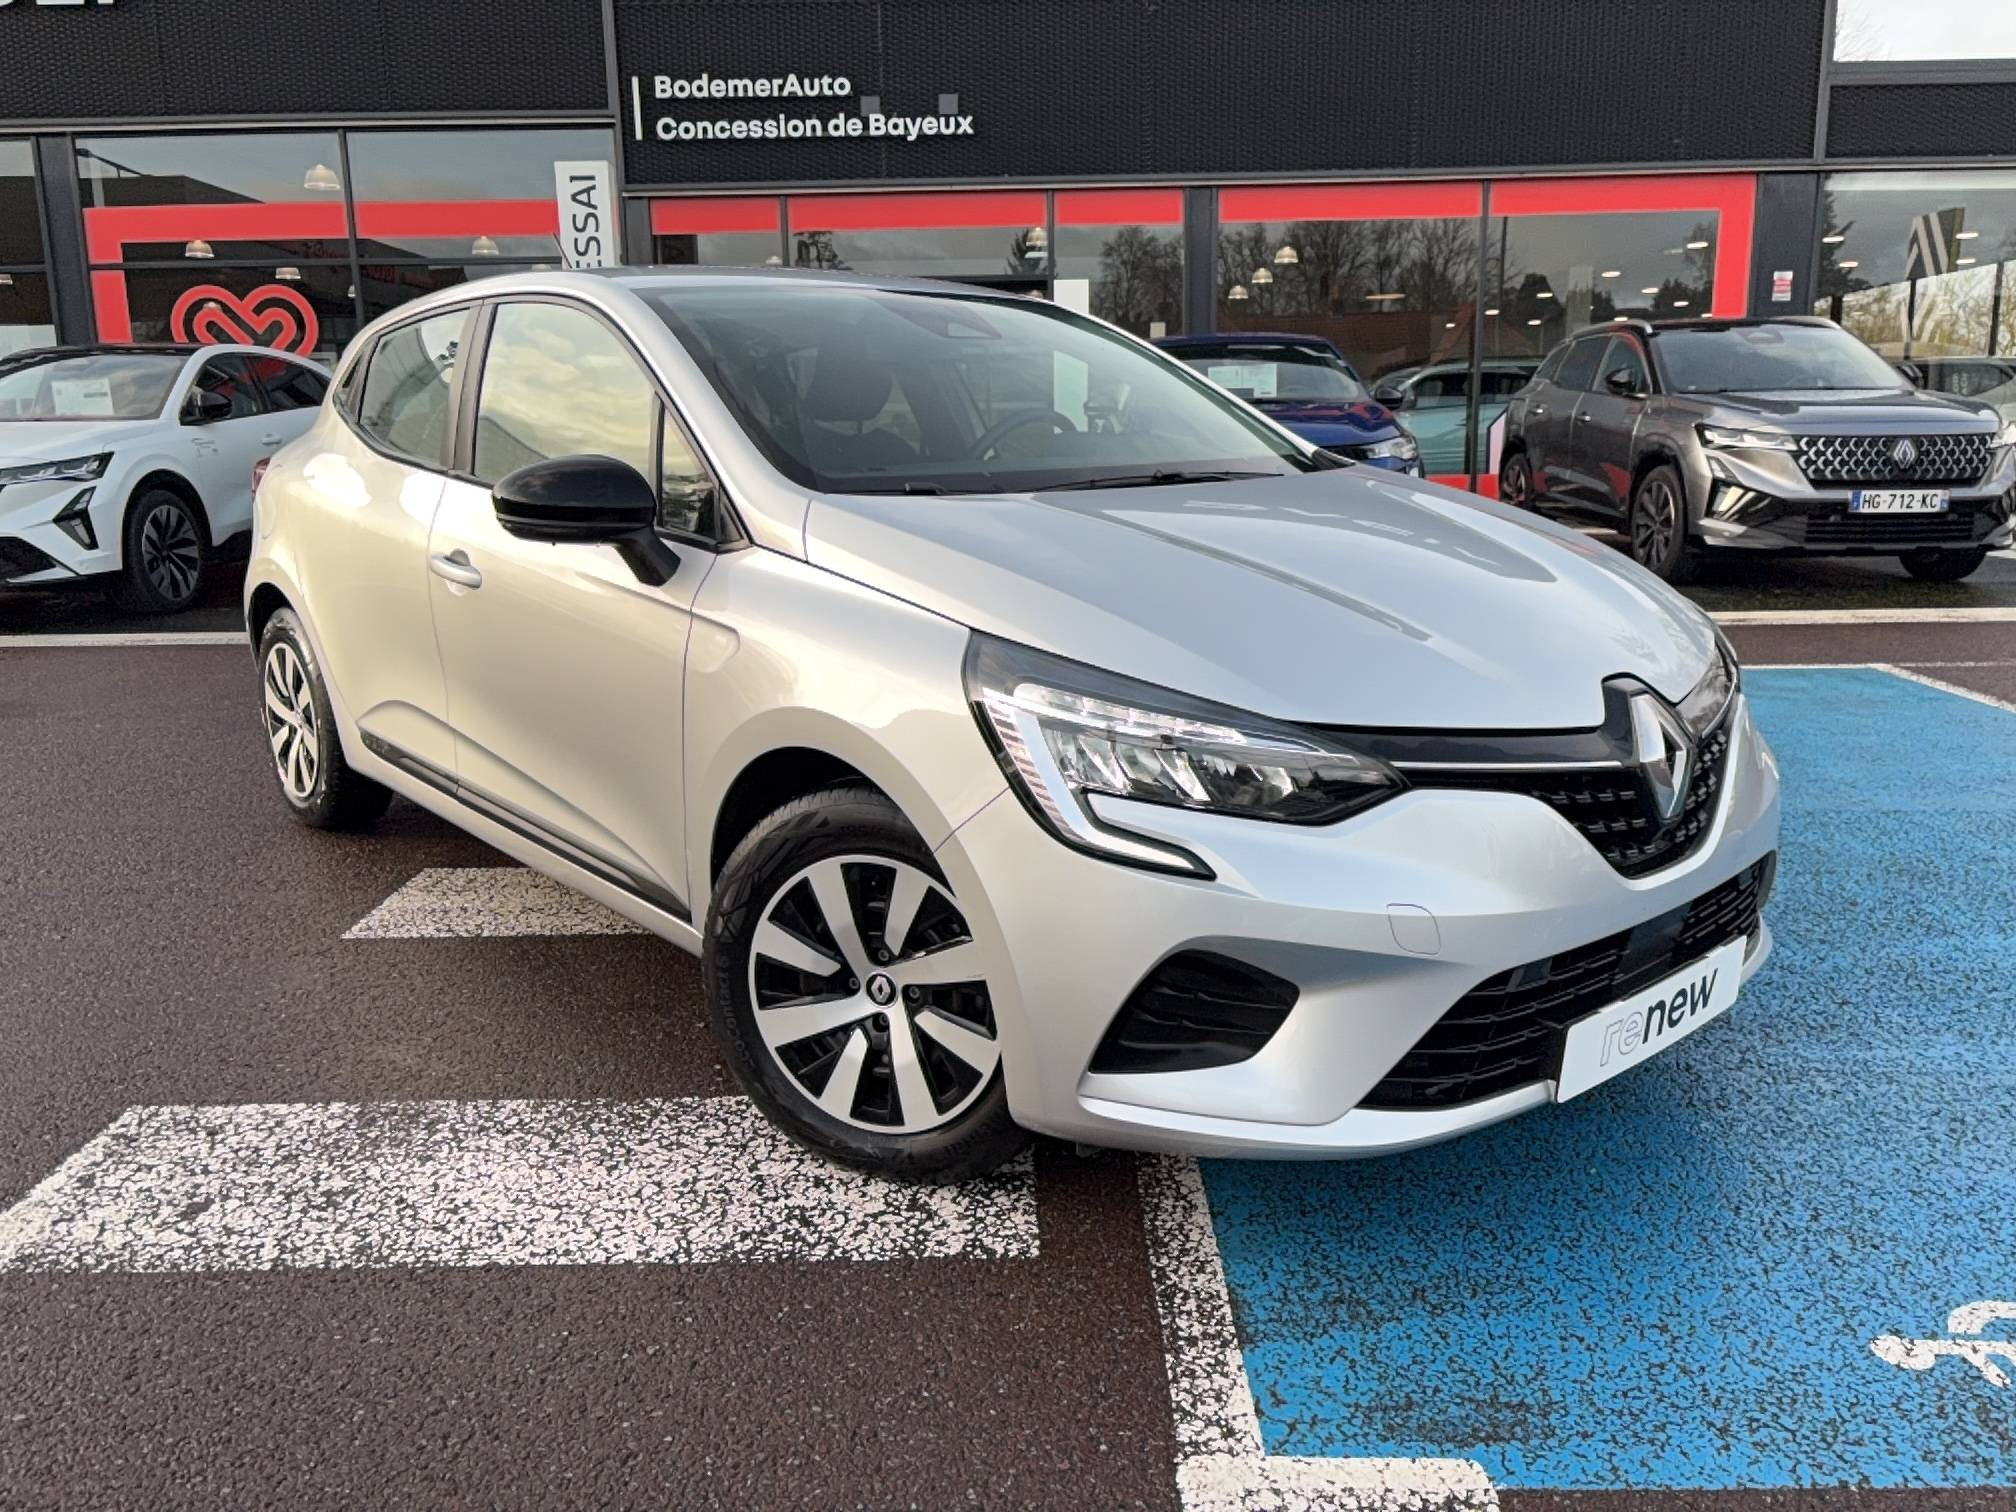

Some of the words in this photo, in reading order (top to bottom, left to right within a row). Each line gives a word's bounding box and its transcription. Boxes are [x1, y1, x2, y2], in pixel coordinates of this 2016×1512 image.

[654, 73, 851, 99] BodemerAuto
[656, 113, 822, 140] Concession
[827, 113, 863, 137] de
[868, 113, 975, 141] Bayeux
[1862, 493, 1938, 509] HG-712-KC
[1600, 967, 1718, 1067] renew
